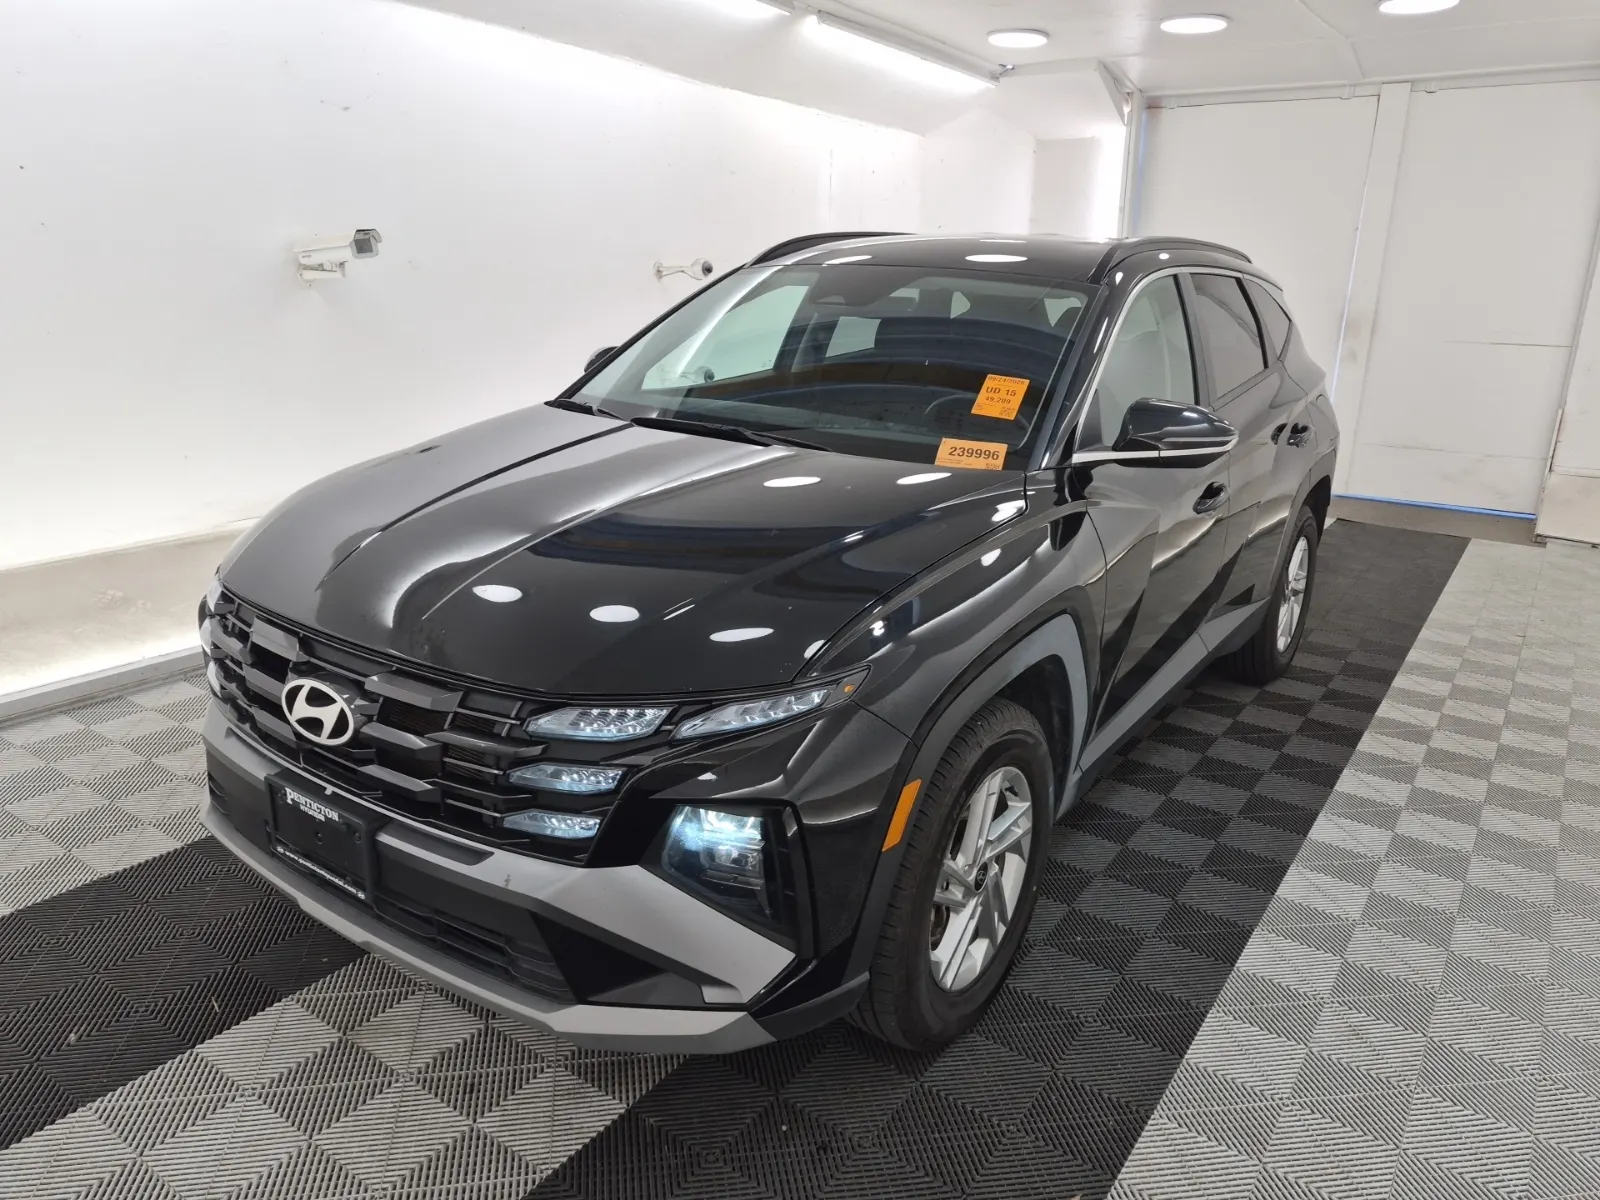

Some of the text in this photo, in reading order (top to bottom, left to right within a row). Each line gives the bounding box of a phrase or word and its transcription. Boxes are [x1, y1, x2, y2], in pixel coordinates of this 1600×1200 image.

[985, 386, 1017, 397] UD 15
[948, 446, 1000, 461] 239996
[284, 787, 339, 822] PENTICTON
